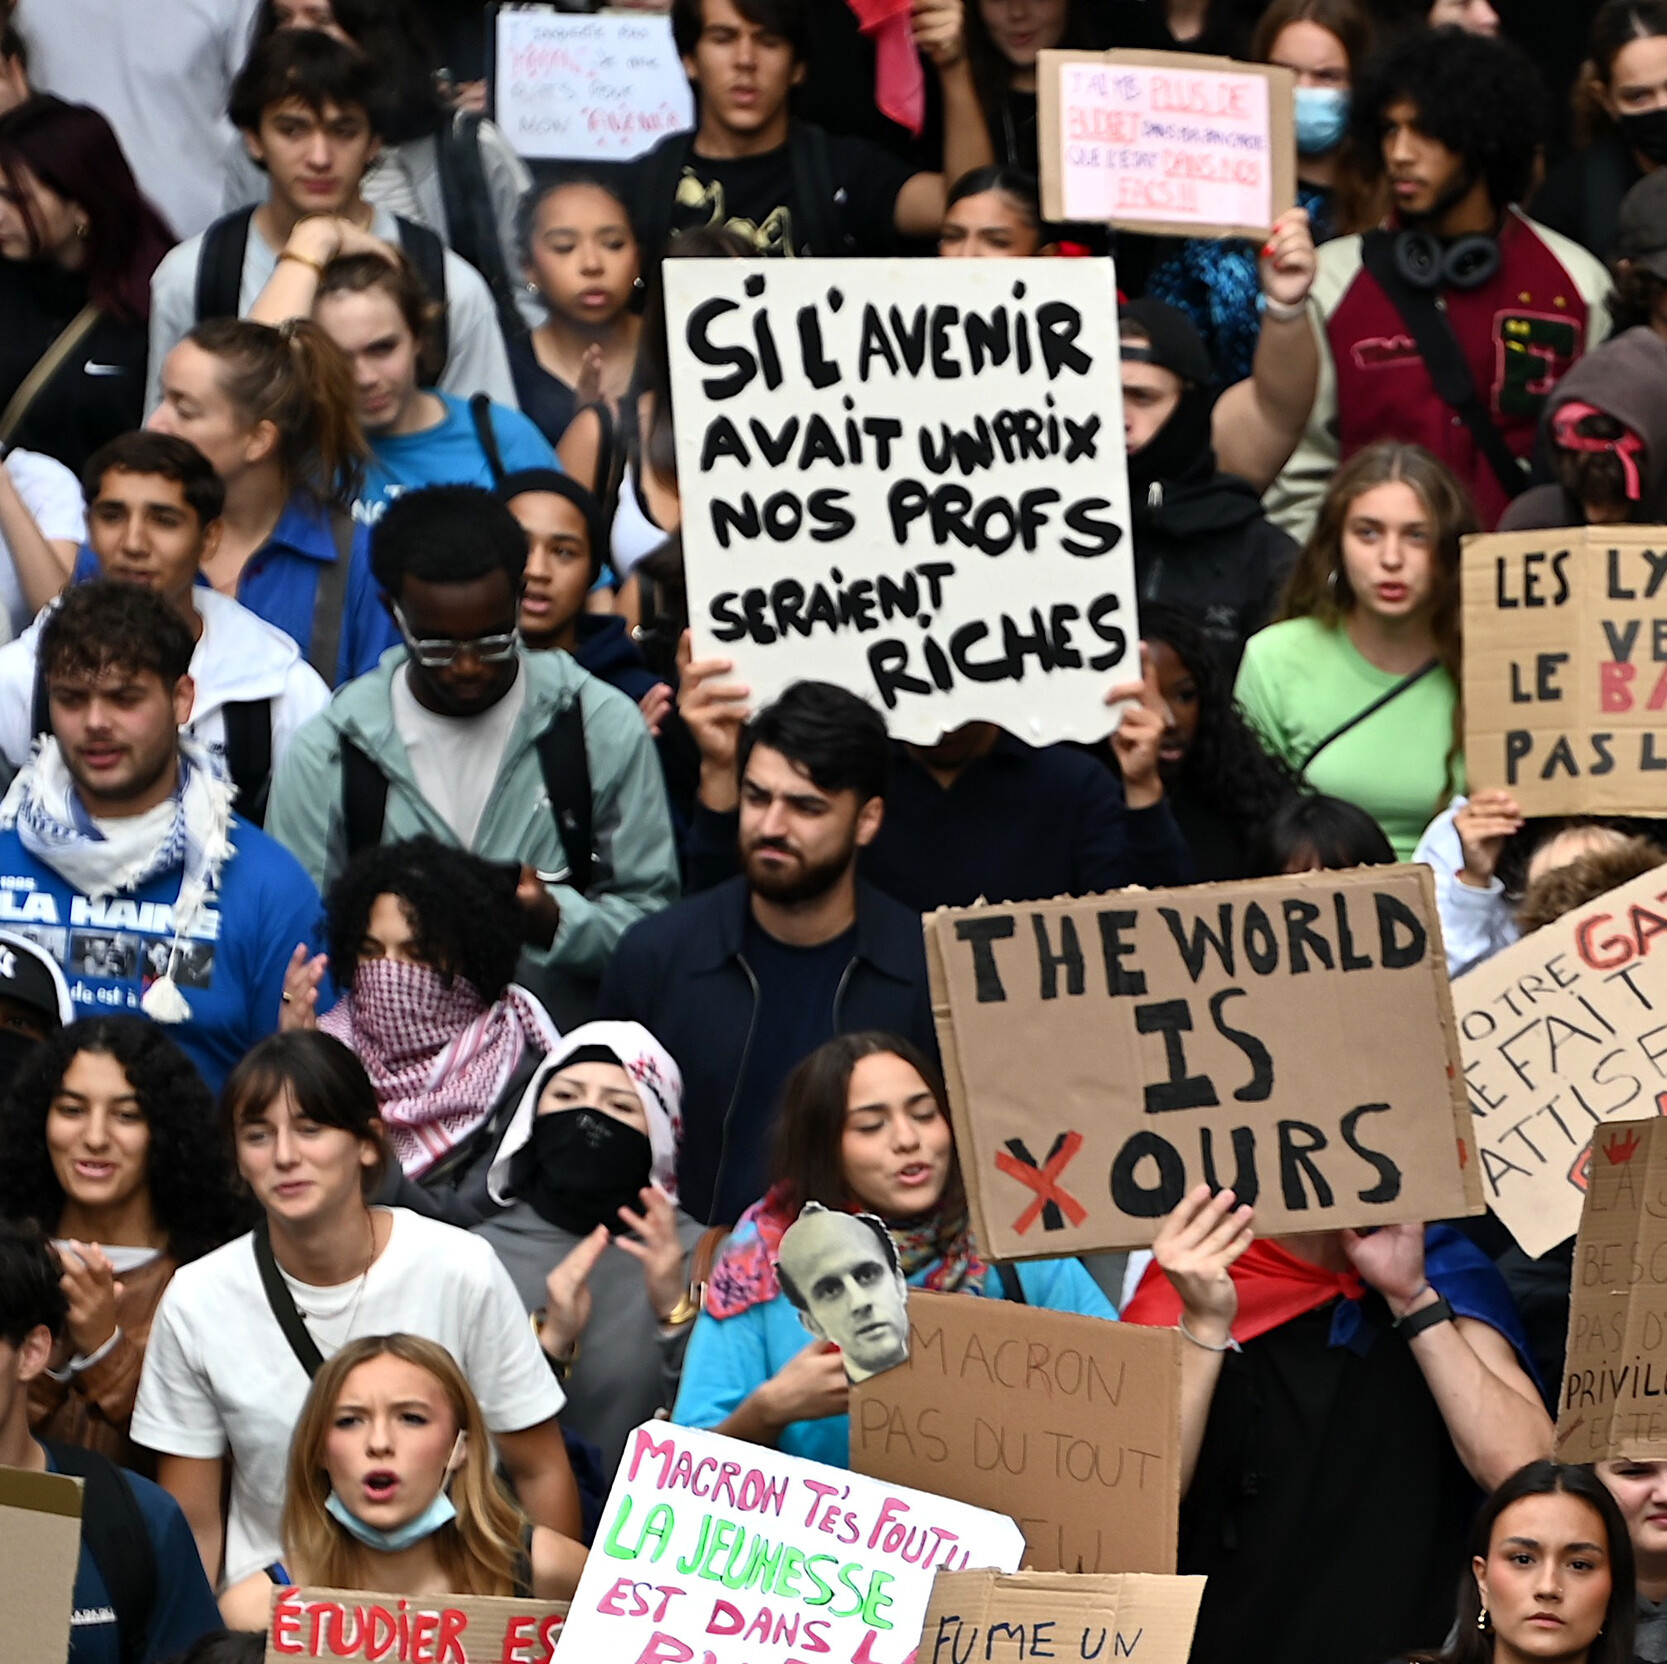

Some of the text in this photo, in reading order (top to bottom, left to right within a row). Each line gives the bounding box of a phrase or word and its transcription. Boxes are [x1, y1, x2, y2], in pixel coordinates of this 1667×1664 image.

[710, 479, 1123, 556] NOS PROFS
[1496, 550, 1571, 607] LES
[1510, 653, 1570, 703] LE
[1506, 730, 1614, 784] PAS
[954, 892, 1427, 1002] THE WORLD
[1134, 988, 1274, 1113] IS
[909, 1323, 1126, 1407] MACRON
[1574, 1311, 1623, 1354] PAS
[627, 1429, 790, 1517] MACRON
[860, 1398, 1162, 1490] PAS DU TOUT
[603, 1493, 895, 1631] LA JEUNESSE
[596, 1577, 832, 1653] EST DANS
[1081, 1628, 1143, 1661] UN
